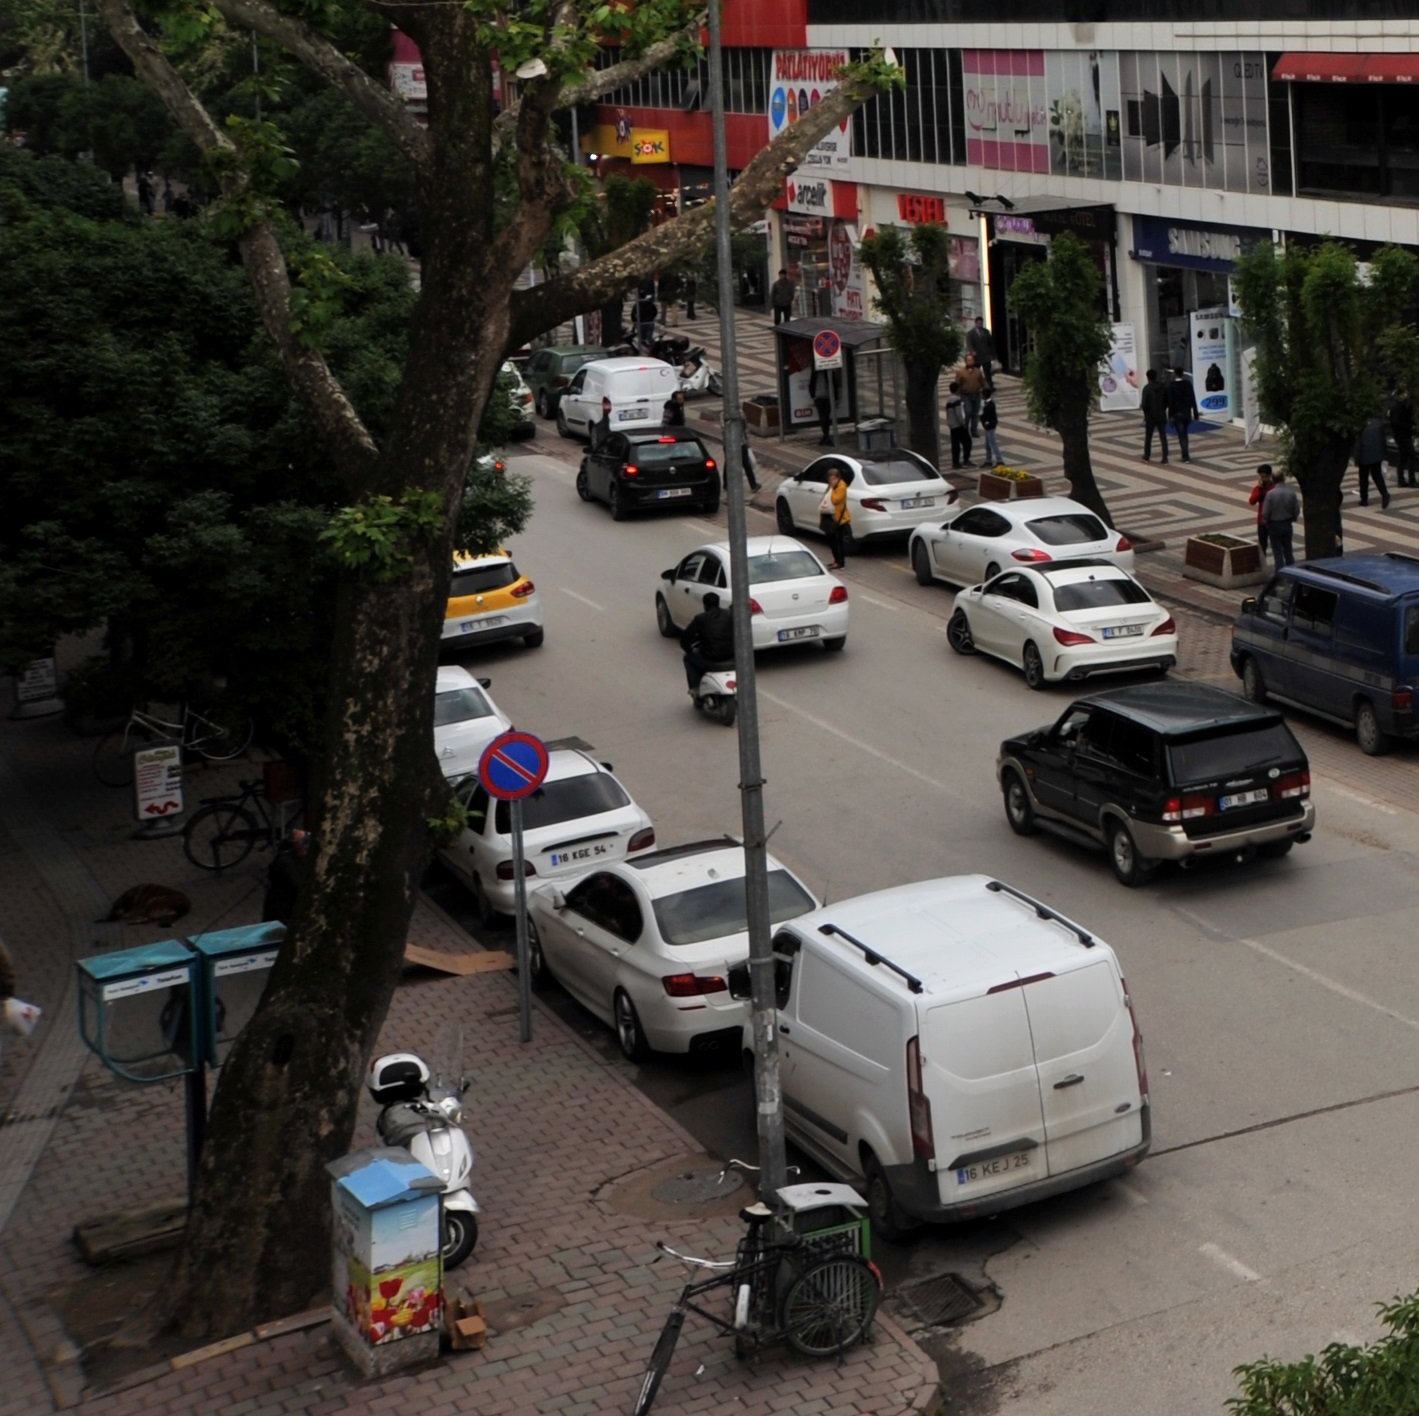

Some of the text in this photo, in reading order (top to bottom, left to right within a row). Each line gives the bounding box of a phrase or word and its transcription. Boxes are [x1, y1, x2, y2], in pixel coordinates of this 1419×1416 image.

[797, 183, 827, 211] arçelik
[897, 194, 947, 226] VESTEL
[1168, 228, 1241, 260] SAMSUNG
[559, 845, 606, 863] 16 KGE 54
[965, 1154, 1029, 1180] 16 KEJ 25
